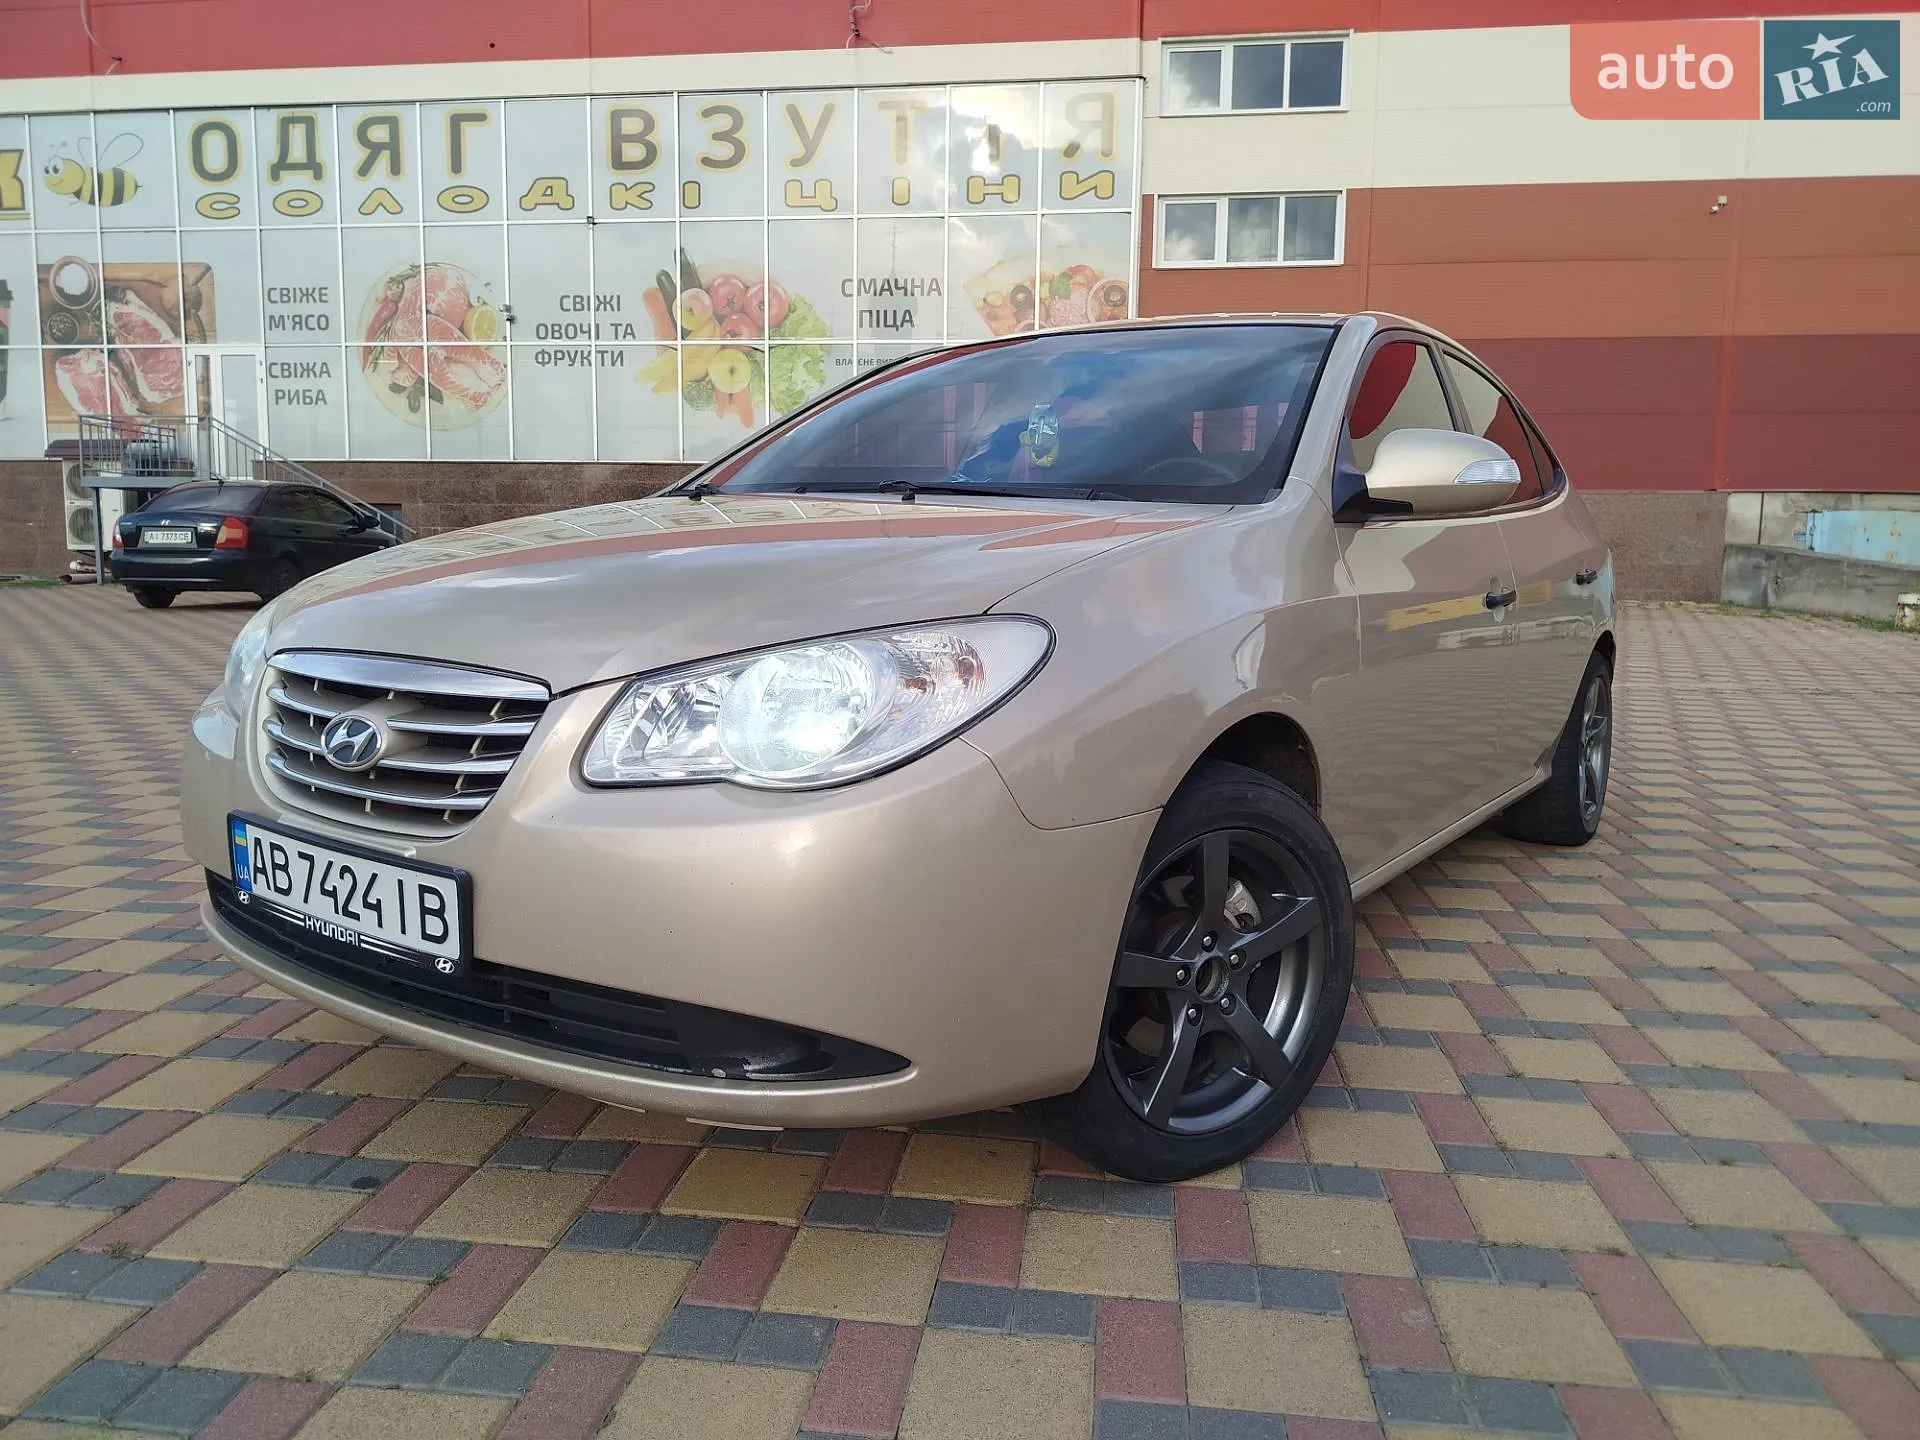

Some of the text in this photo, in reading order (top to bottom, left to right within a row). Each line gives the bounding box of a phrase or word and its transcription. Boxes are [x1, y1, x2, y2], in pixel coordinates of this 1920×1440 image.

[189, 109, 490, 184] ОДЯГ
[784, 169, 1115, 212] ЦІНИ
[267, 286, 329, 304] СВІЖЕ
[840, 277, 943, 298] СМАЧНА
[559, 294, 621, 312] СВІЖІ
[268, 313, 330, 331] М'ЯСО
[858, 308, 916, 332] ПІЦА
[535, 322, 637, 340] ОВОЧІ ТА
[534, 348, 624, 368] ФРУКТИ
[268, 361, 332, 379] СВІЖА
[274, 388, 328, 406] РИБА
[237, 863, 250, 880] UA
[305, 915, 359, 947] HYUNDAI
